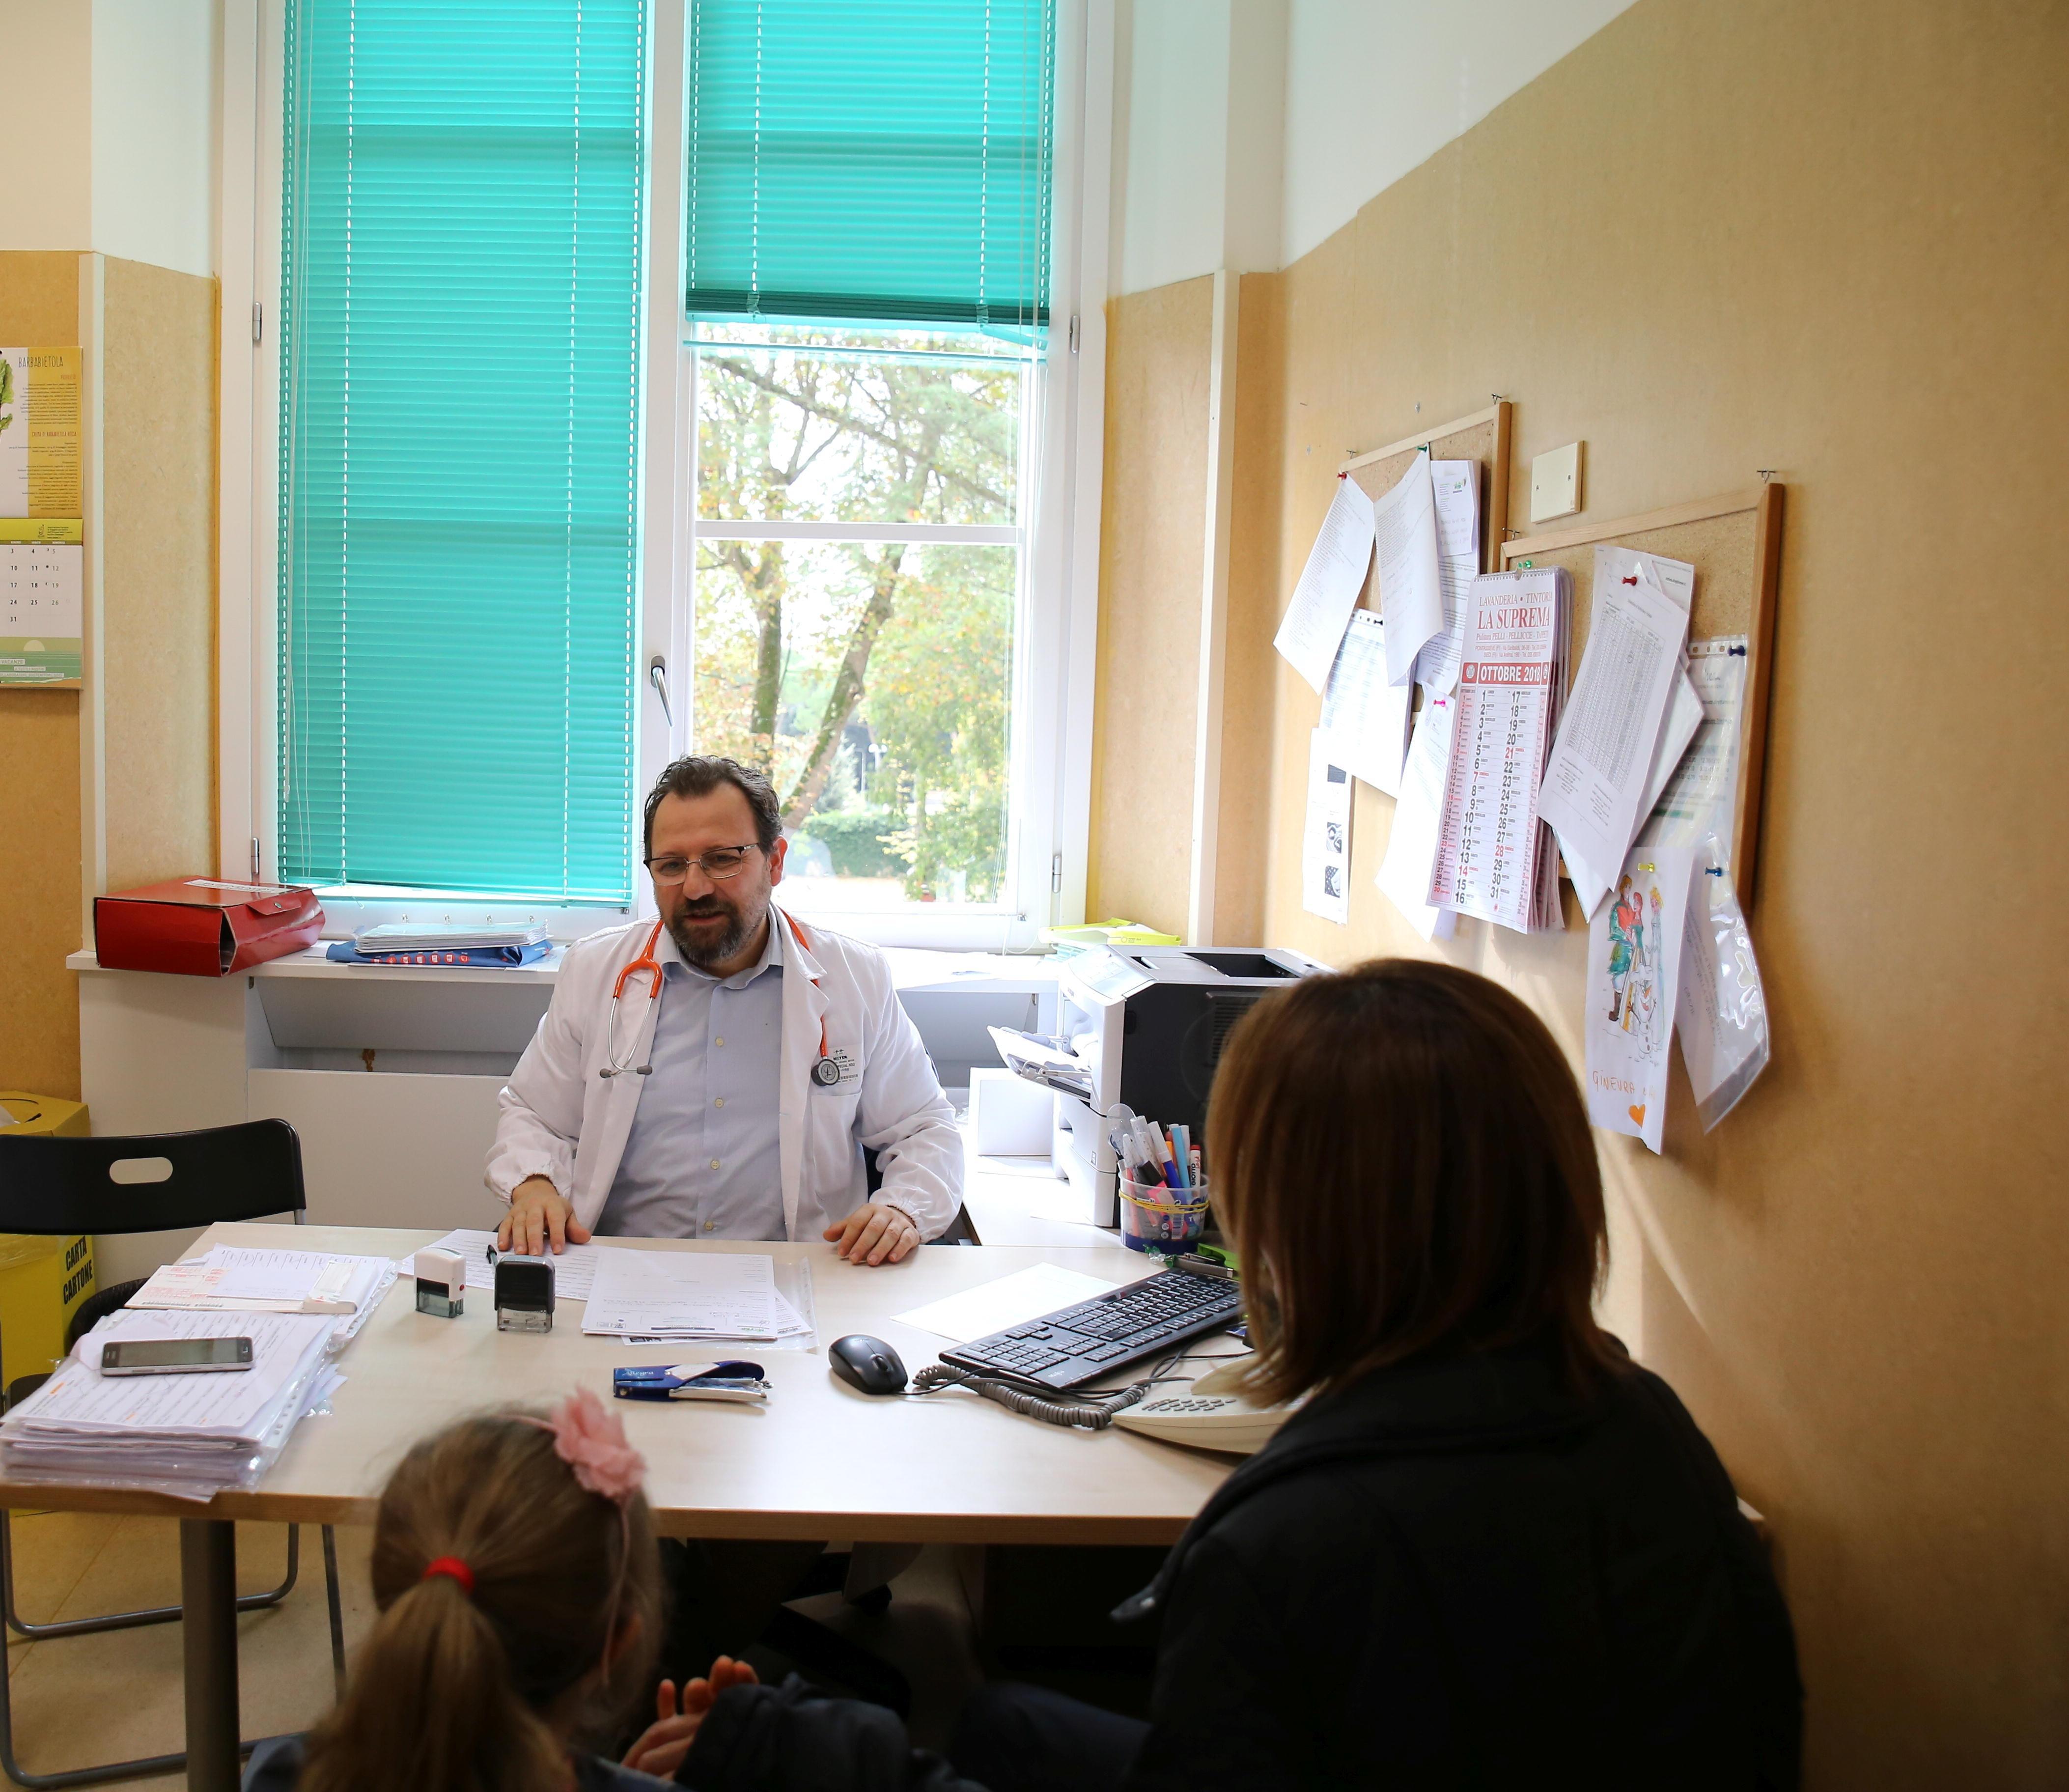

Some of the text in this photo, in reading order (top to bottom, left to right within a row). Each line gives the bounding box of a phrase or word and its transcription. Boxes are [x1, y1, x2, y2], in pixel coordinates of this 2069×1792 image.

[19, 356, 63, 368] BARBABIETOLA
[1479, 594, 1518, 607] LAVANDERIA
[1478, 606, 1550, 629] LA SUPREMA
[1481, 666, 1540, 682] OTTOBRE 2018
[1482, 690, 1486, 701] 1
[1512, 691, 1521, 703] 17
[1480, 703, 1485, 715] 2
[1510, 705, 1519, 717] 18
[1479, 717, 1484, 729] 3
[1509, 719, 1517, 731] 19
[1477, 731, 1482, 742] 4
[1507, 733, 1516, 745] 20
[1476, 744, 1481, 756] 5
[1505, 747, 1514, 759] 21
[1475, 758, 1480, 769] 6
[1504, 761, 1513, 774] 22
[1474, 771, 1479, 783] 7
[1502, 775, 1511, 787] 23
[1471, 785, 1477, 796] 8
[1501, 789, 1510, 802] 24
[1470, 798, 1475, 810] 9
[1499, 803, 1508, 815] 25
[1465, 811, 1474, 823] 10
[1498, 817, 1507, 830] 26
[1463, 824, 1472, 837] 11
[1496, 831, 1506, 843] 27
[1461, 838, 1471, 850] 12
[1495, 844, 1504, 857] 28
[1460, 851, 1469, 864] 13
[1458, 865, 1468, 877] 14
[1493, 859, 1503, 871] 29
[1457, 878, 1466, 891] 15
[1492, 872, 1501, 885] 30
[1455, 891, 1465, 904] 16
[1490, 886, 1499, 899] 31
[66, 1235, 87, 1271] CARTA
[63, 1259, 93, 1305] CARTONE
